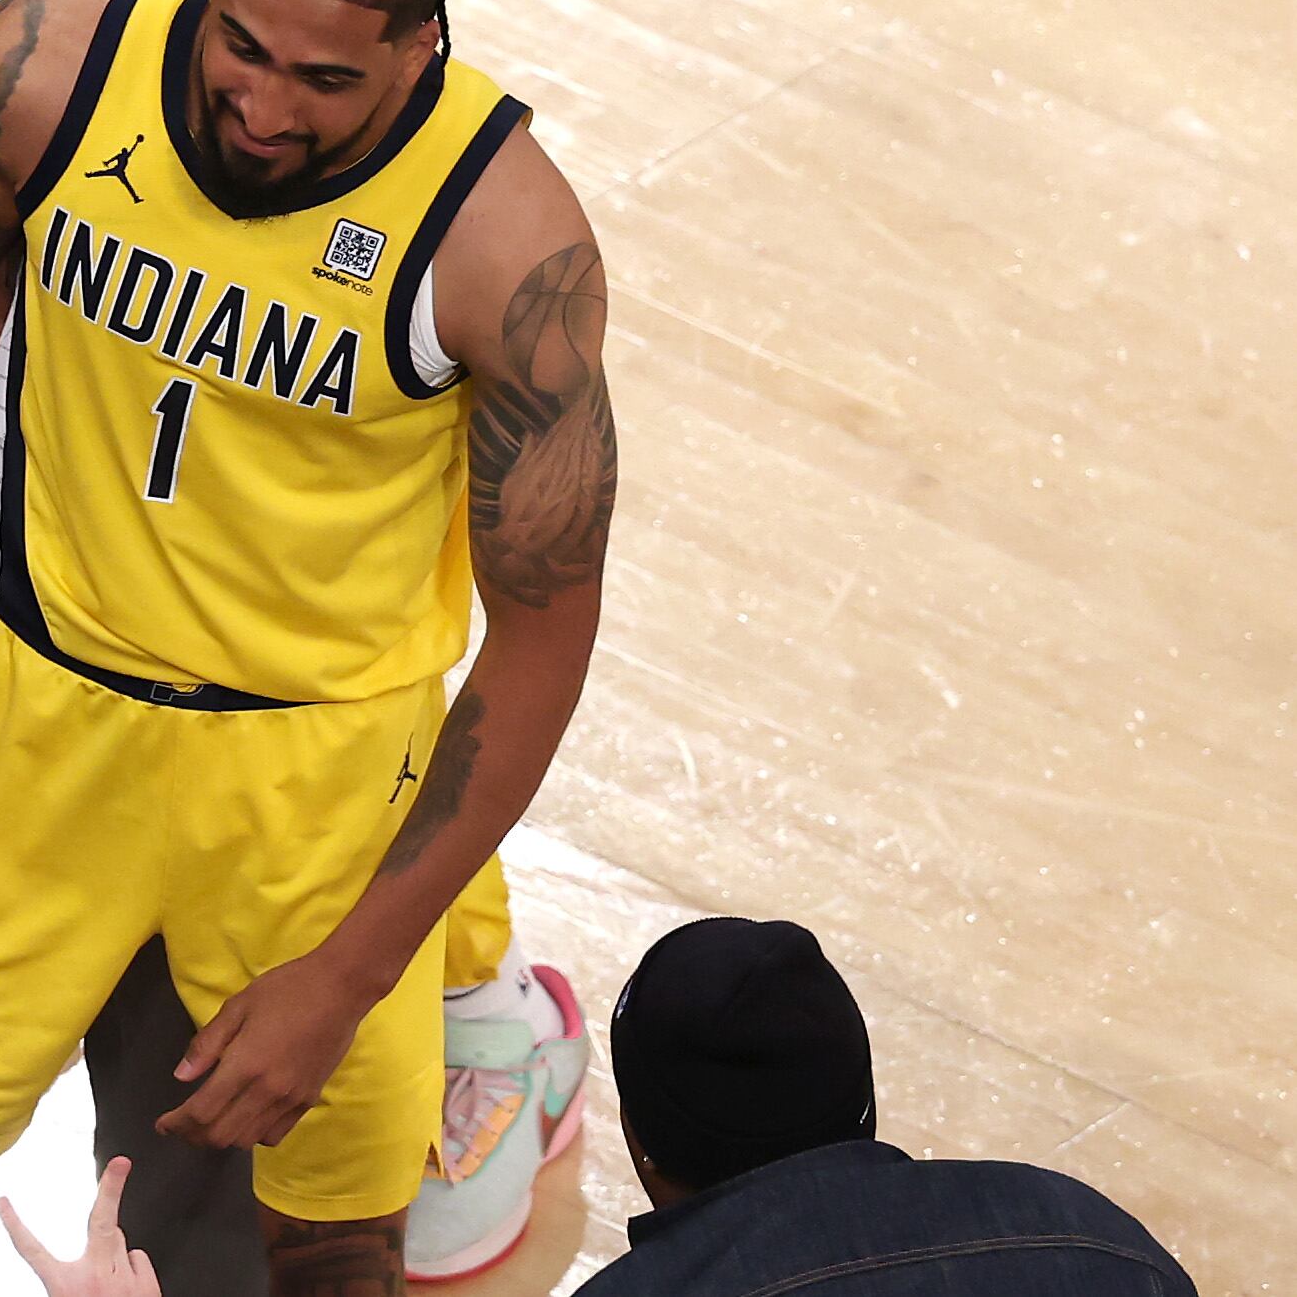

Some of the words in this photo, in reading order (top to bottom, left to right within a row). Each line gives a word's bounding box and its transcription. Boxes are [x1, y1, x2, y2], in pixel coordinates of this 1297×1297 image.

[40, 206, 361, 416] INDIANA
[311, 267, 373, 296] spokenote
[143, 378, 196, 503] 1
